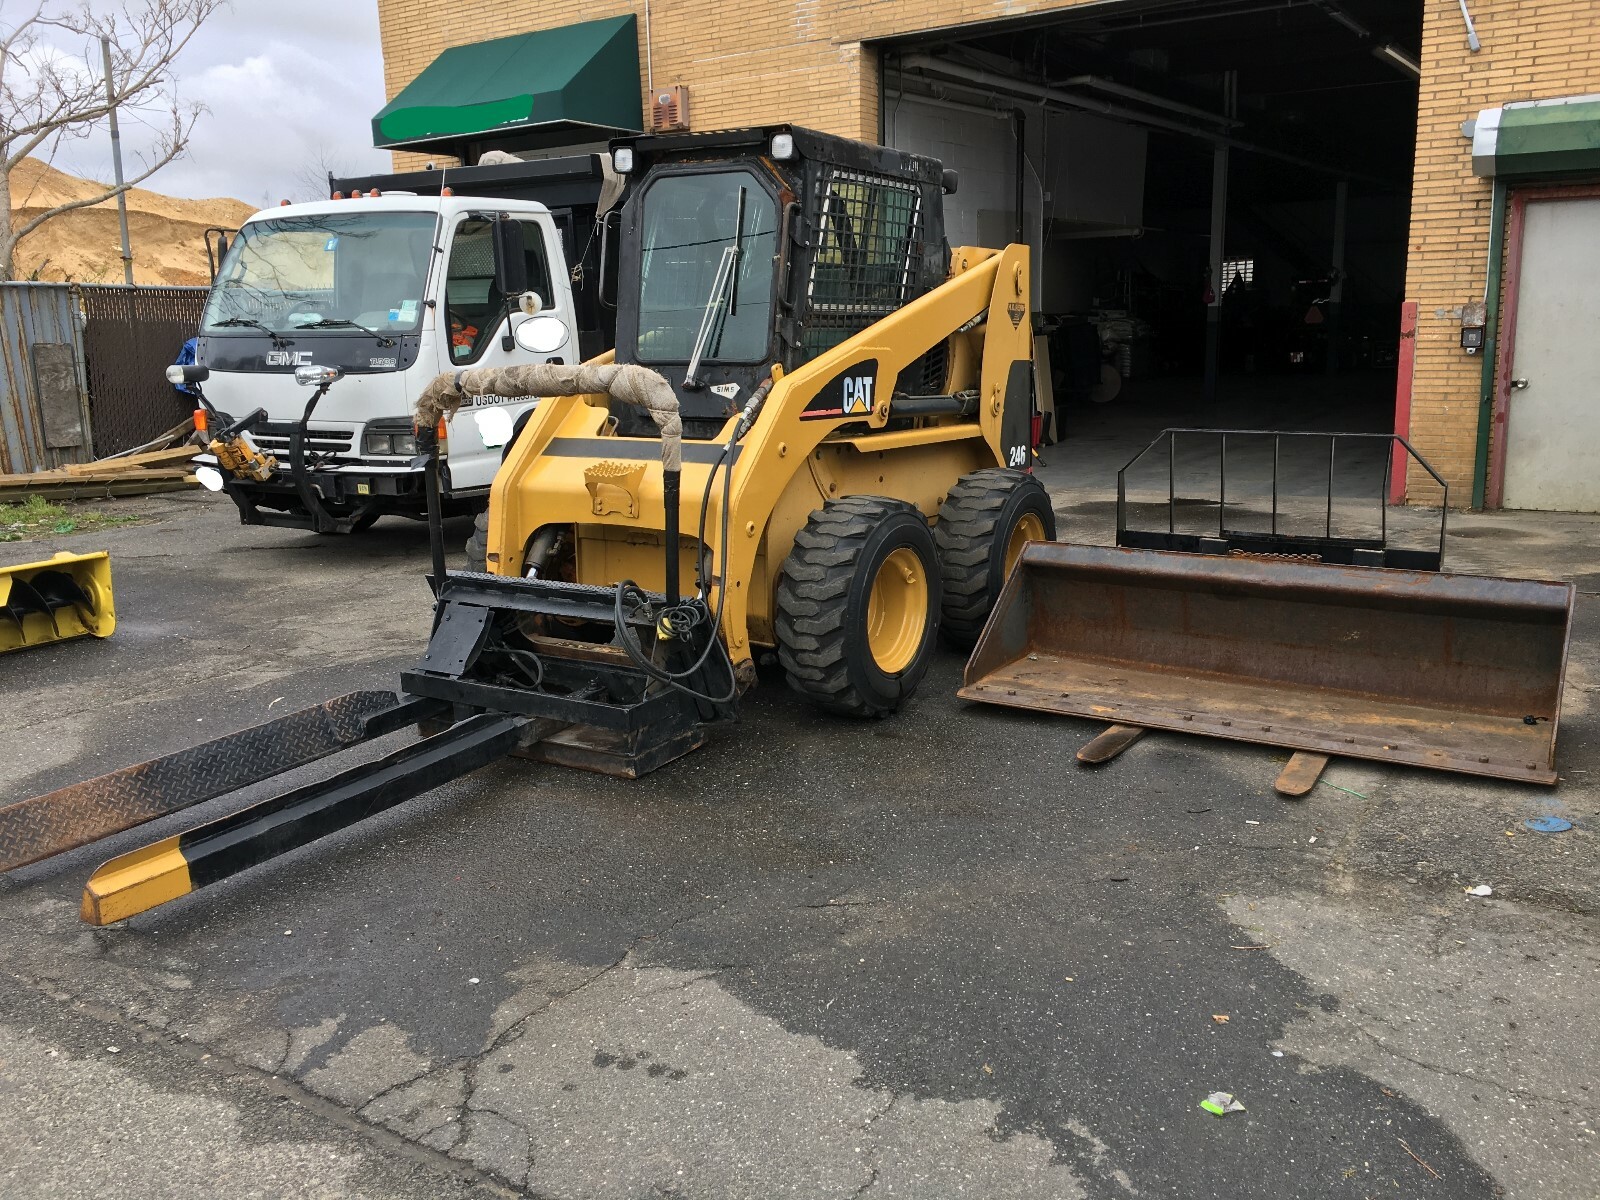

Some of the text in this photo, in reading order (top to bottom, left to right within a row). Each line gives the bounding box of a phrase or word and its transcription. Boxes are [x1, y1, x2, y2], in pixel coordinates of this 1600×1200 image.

[265, 351, 313, 366] GMC
[716, 385, 735, 393] SIMS
[843, 376, 873, 413] CAT
[475, 394, 504, 406] USDOT
[1009, 444, 1026, 467] 246
